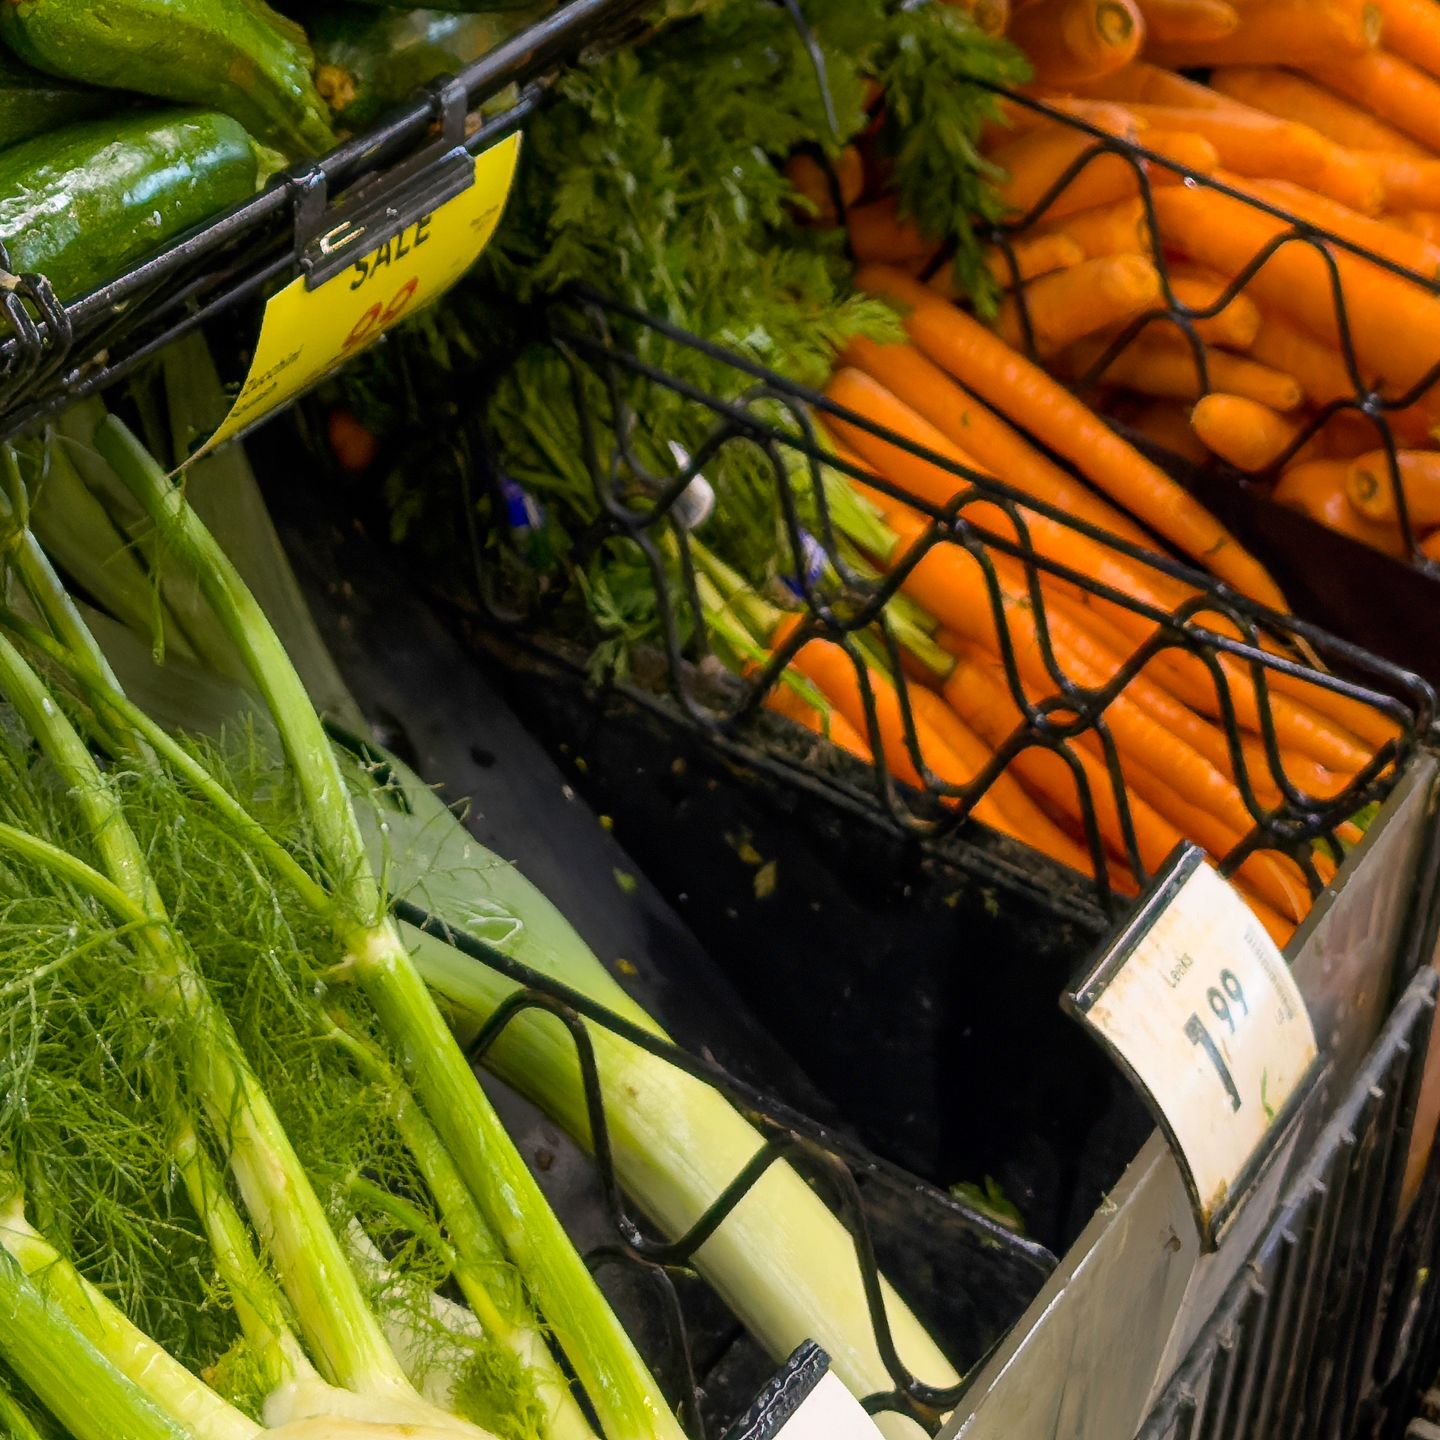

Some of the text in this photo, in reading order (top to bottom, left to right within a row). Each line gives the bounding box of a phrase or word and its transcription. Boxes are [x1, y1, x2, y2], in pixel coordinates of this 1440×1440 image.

[349, 214, 433, 291] SALE
[1182, 967, 1250, 1113] 1 99
